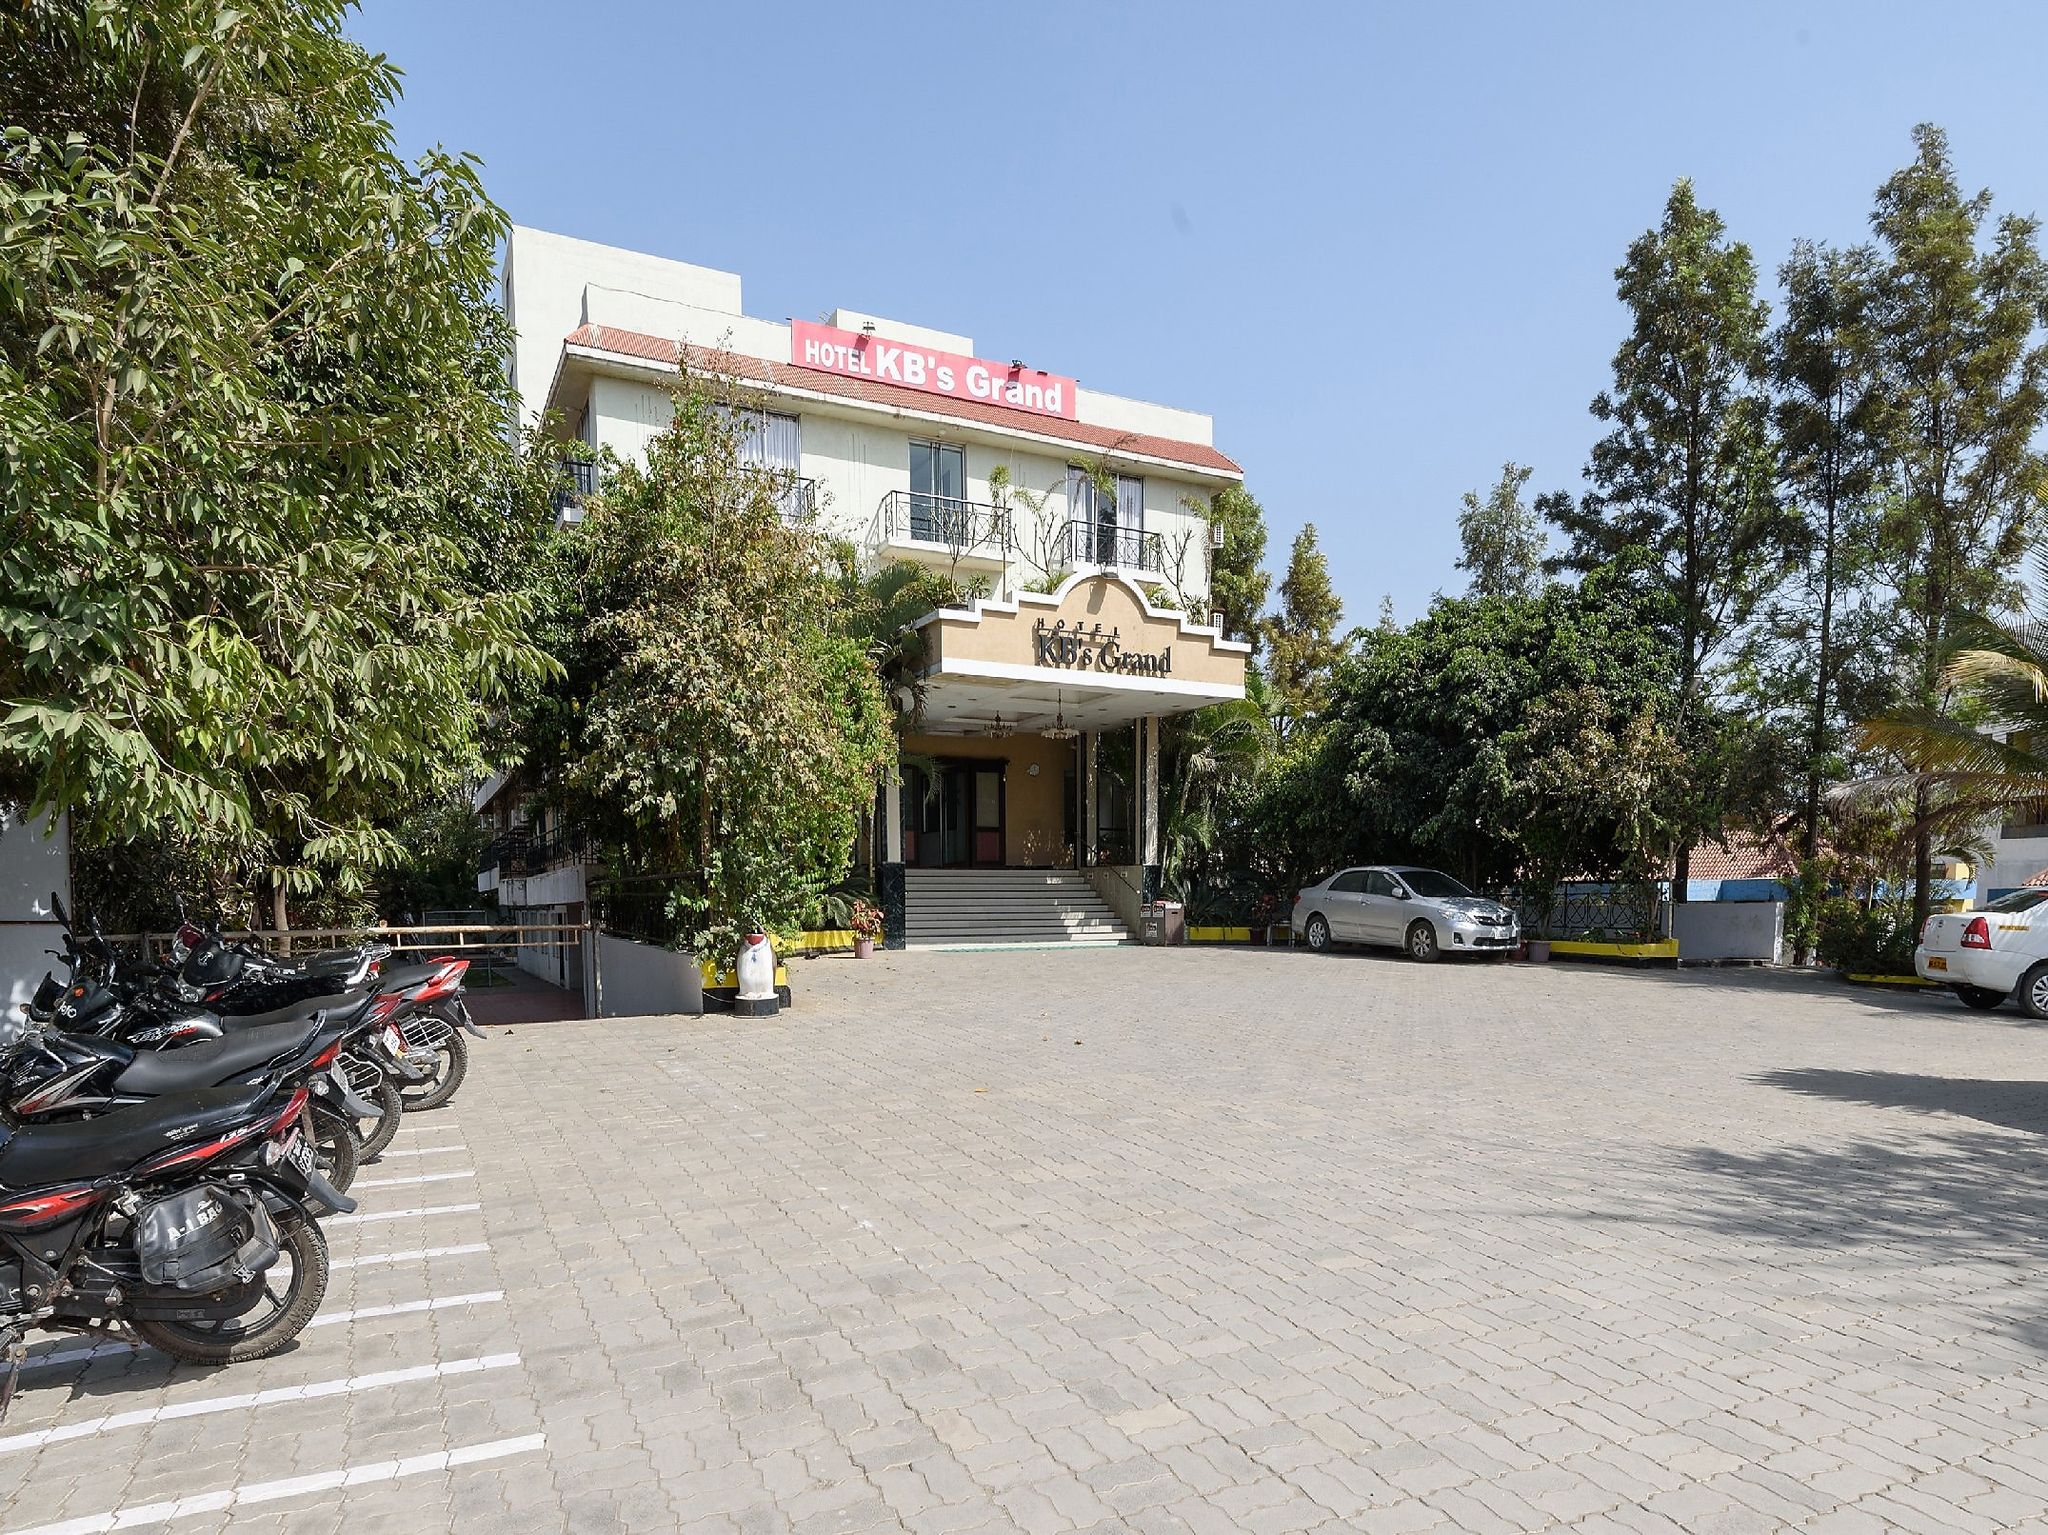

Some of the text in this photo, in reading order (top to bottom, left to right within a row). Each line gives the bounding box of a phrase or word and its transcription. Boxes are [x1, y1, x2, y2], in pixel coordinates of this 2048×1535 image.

[804, 338, 1063, 414] HOTEL KB's Grand
[1037, 617, 1119, 637] HOTEL
[1039, 634, 1173, 673] KB's Grand
